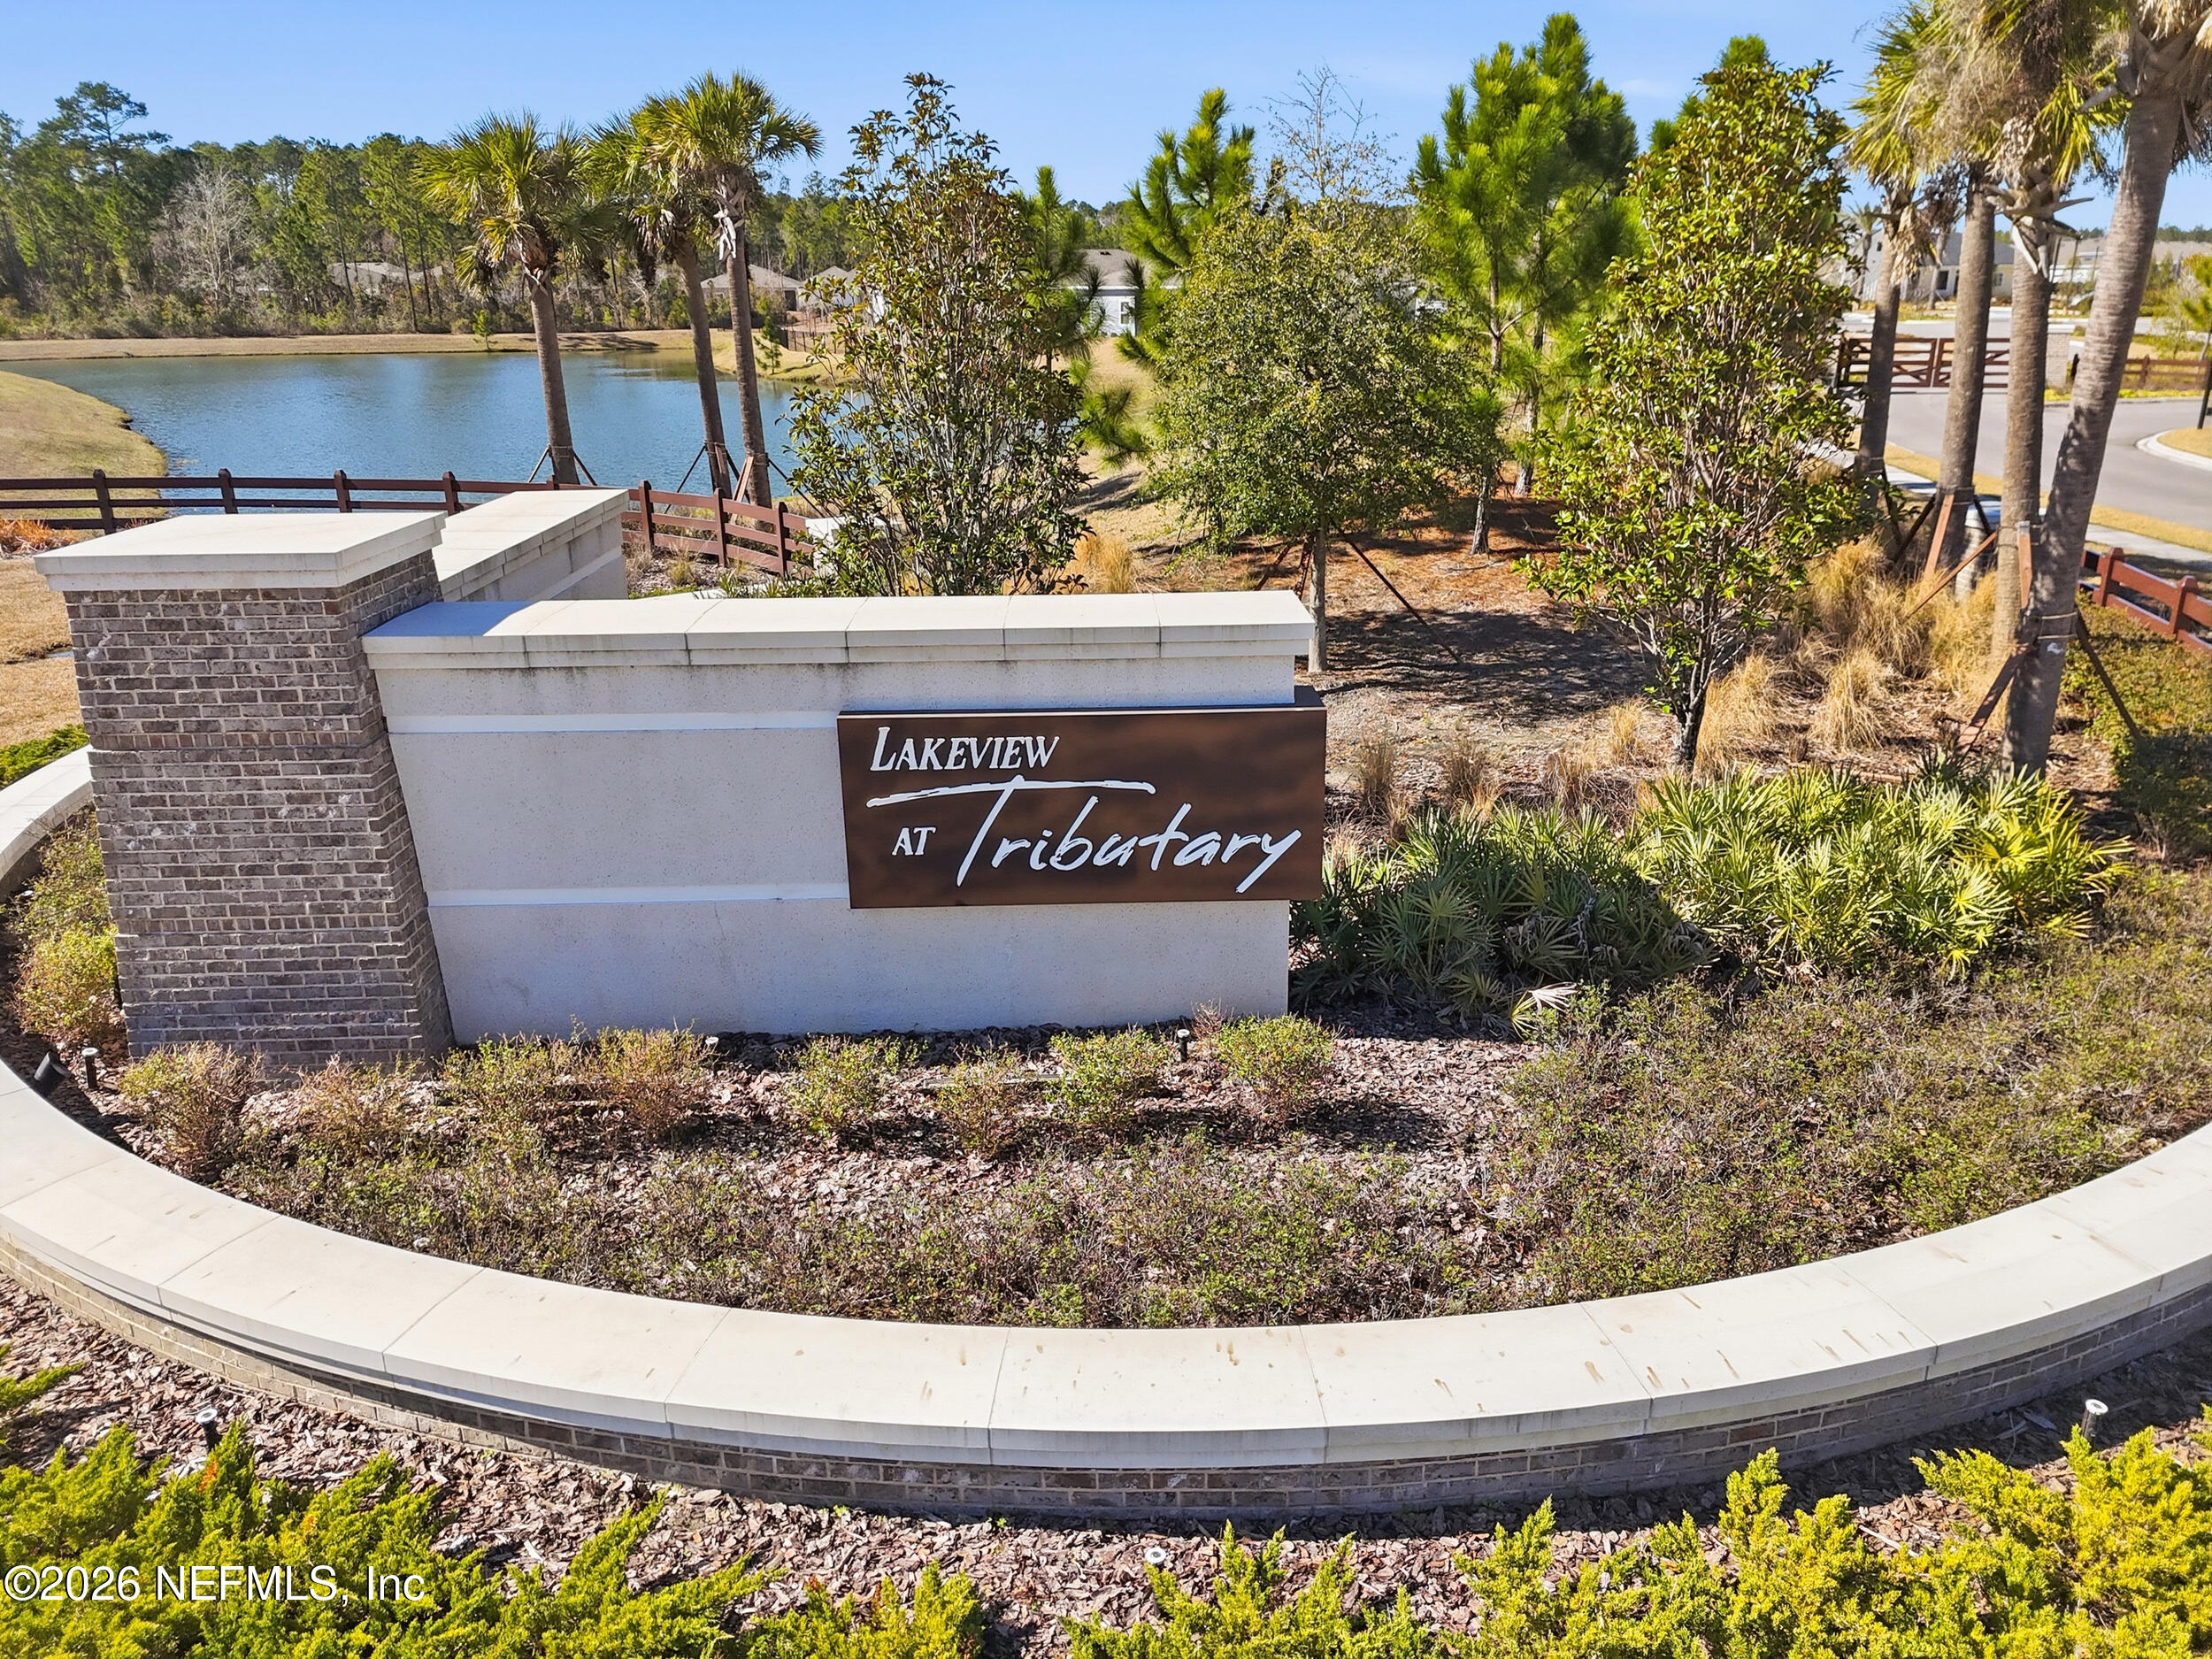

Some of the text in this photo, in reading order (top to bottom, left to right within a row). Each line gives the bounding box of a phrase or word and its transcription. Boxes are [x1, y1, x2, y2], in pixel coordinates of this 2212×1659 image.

[870, 726, 1060, 772] LAKEVIEW
[865, 774, 1302, 894] AT Tributary
